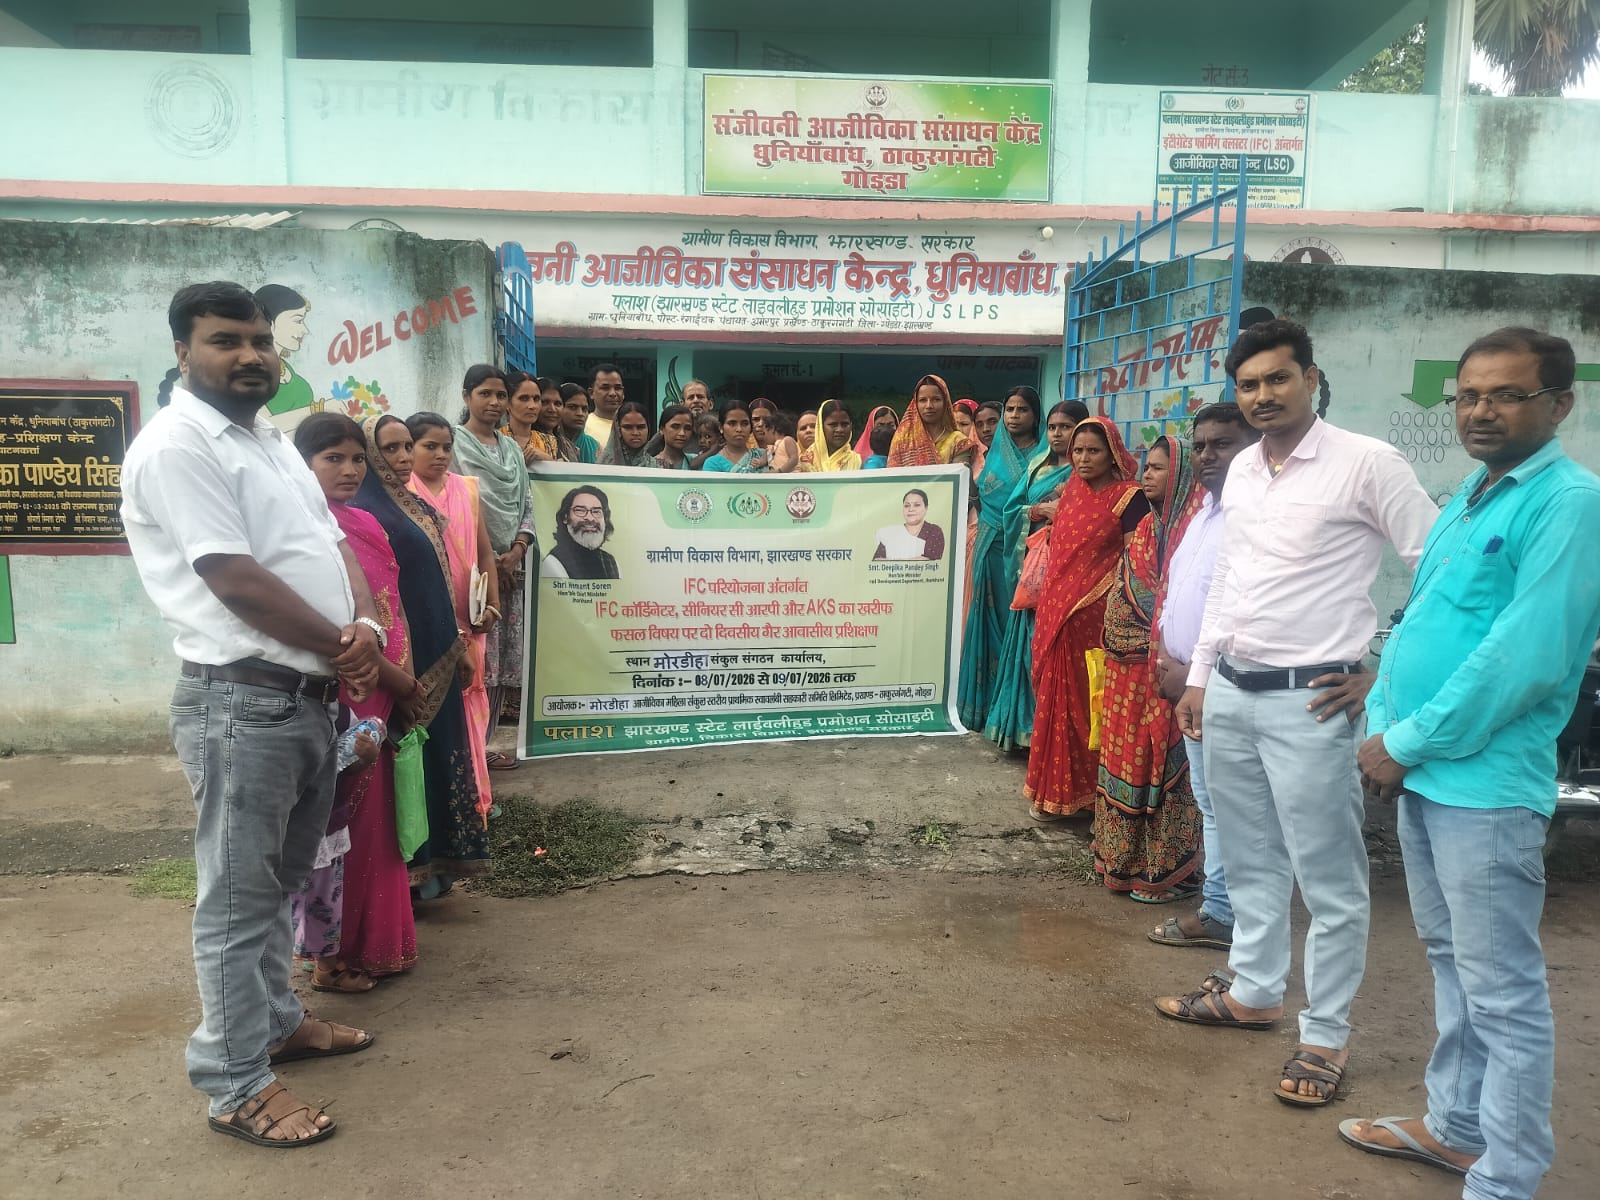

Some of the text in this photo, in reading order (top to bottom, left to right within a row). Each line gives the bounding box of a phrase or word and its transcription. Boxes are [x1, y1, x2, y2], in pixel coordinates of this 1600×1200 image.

[712, 109, 1044, 146] संजीवनी आजीविका संसाधन केंद्र
[1250, 137, 1272, 153] (IFC)
[880, 143, 998, 171] ठाकुरगंगटी
[1220, 156, 1237, 169] सेवा
[1263, 158, 1290, 172] (LSC)
[842, 166, 909, 194] गोड्डा
[682, 229, 725, 247] ग्रामीण
[728, 229, 770, 247] विकास
[582, 246, 728, 290] आजीविका
[728, 249, 840, 294] संसाधन
[612, 294, 650, 312] पलाश
[711, 292, 739, 313] स्टेट
[811, 297, 855, 318] प्रमोशन
[327, 285, 478, 366] WELCOME
[66, 431, 95, 444] केन्द्र
[23, 457, 81, 486] पाण्डेय
[85, 456, 121, 487] सिंह
[647, 546, 852, 565] ग्रामीण विकास विभाग, झारखण्ड सरकार
[552, 581, 566, 589] Shri
[592, 582, 611, 590] Soren
[684, 577, 808, 594] IFC परियोजना अंतर्गत
[595, 601, 618, 618] IFC
[682, 601, 727, 617] सीनियर
[729, 601, 744, 616] सी
[746, 601, 780, 616] आरपी
[782, 600, 805, 616] और
[806, 598, 836, 615] AKS
[838, 602, 855, 615] का
[857, 599, 893, 615] खरीफ
[610, 621, 879, 641] फसल विषय पर दो दिवसीय गैर आवासीय प्रशिक्षण
[625, 650, 826, 670] स्थान मोरडीहा संकुल संगठन कार्यालय,
[632, 673, 676, 688] दिनांक
[695, 673, 755, 688] 08/07/2026
[757, 672, 770, 685] से
[772, 671, 831, 687] 09/07/2026
[833, 672, 857, 683] तक
[589, 698, 630, 711] मोरडीहा
[633, 696, 665, 709] आजीविका
[665, 695, 687, 707] महिला
[687, 694, 706, 709] संकुल
[706, 694, 727, 706] स्तरीय
[783, 691, 807, 703] सहकारी
[808, 690, 828, 702] समिति
[543, 725, 616, 740] पलाश
[624, 723, 690, 737] झारखण्ड
[694, 717, 728, 733] स्टेट
[817, 712, 871, 728] प्रमोशन
[875, 708, 935, 724] सोसाइटी
